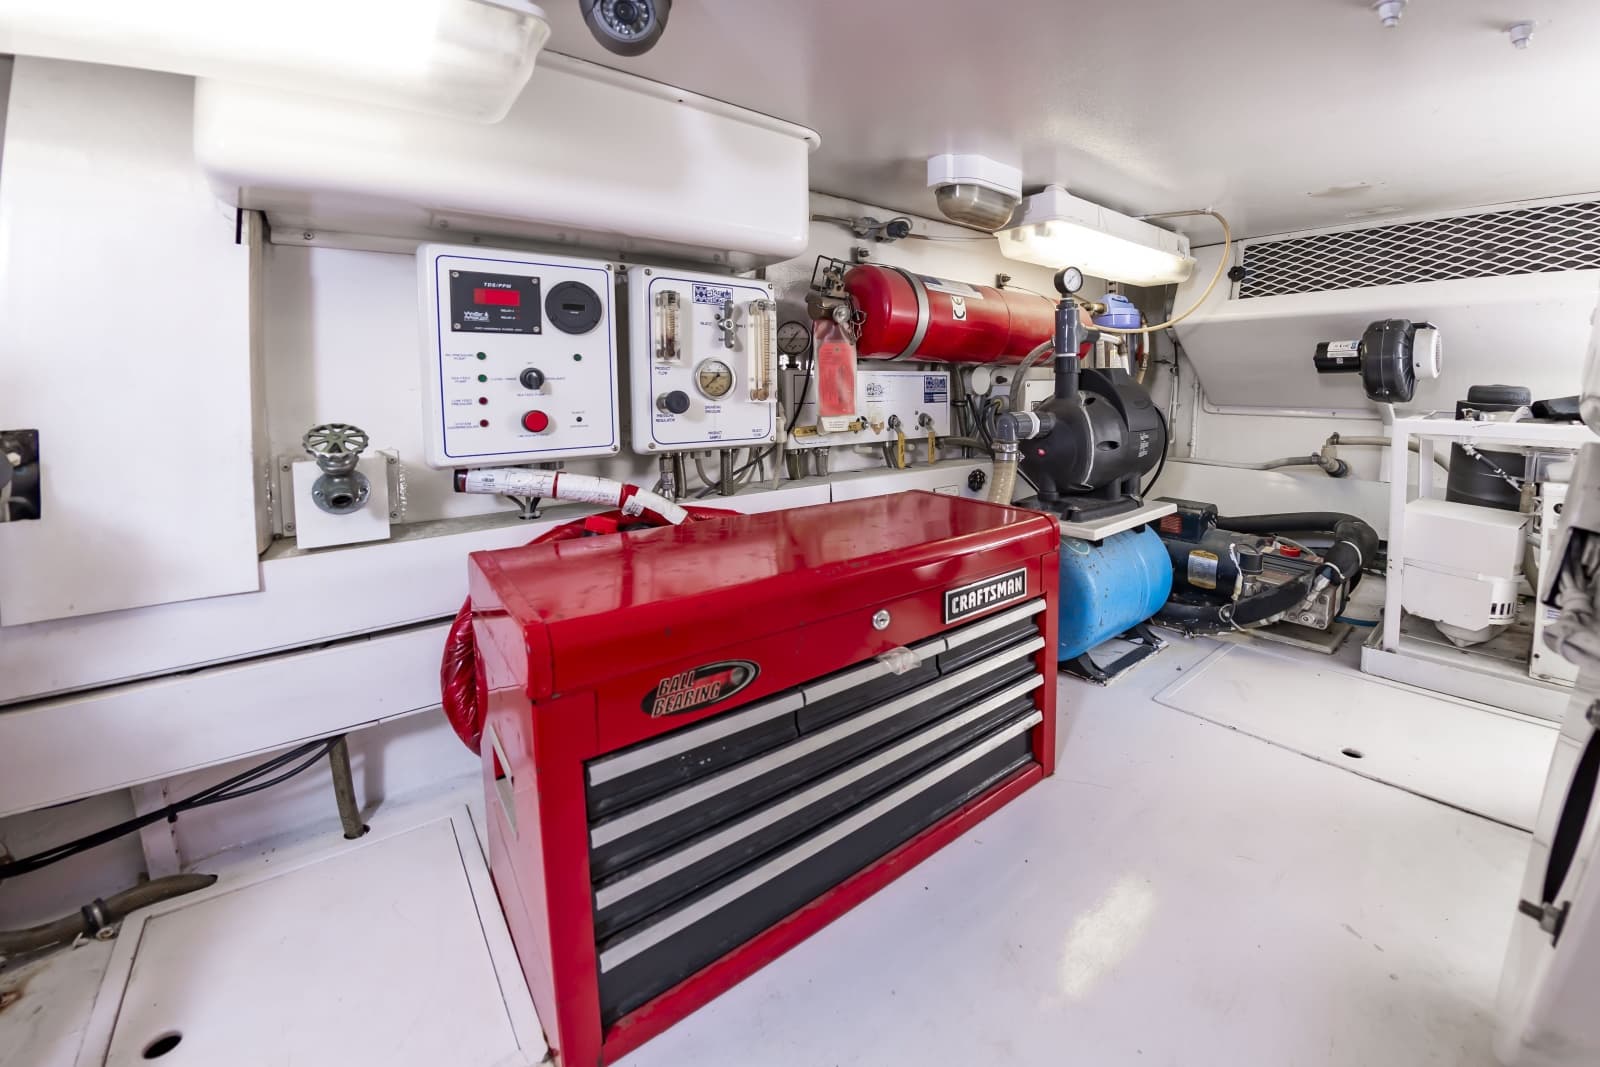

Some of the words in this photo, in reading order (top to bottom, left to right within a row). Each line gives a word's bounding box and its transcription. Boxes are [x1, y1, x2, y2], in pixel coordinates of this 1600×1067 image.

[951, 576, 1023, 614] CRAFTSMAN
[651, 680, 721, 718] BEARING
[656, 670, 696, 698] BALL
